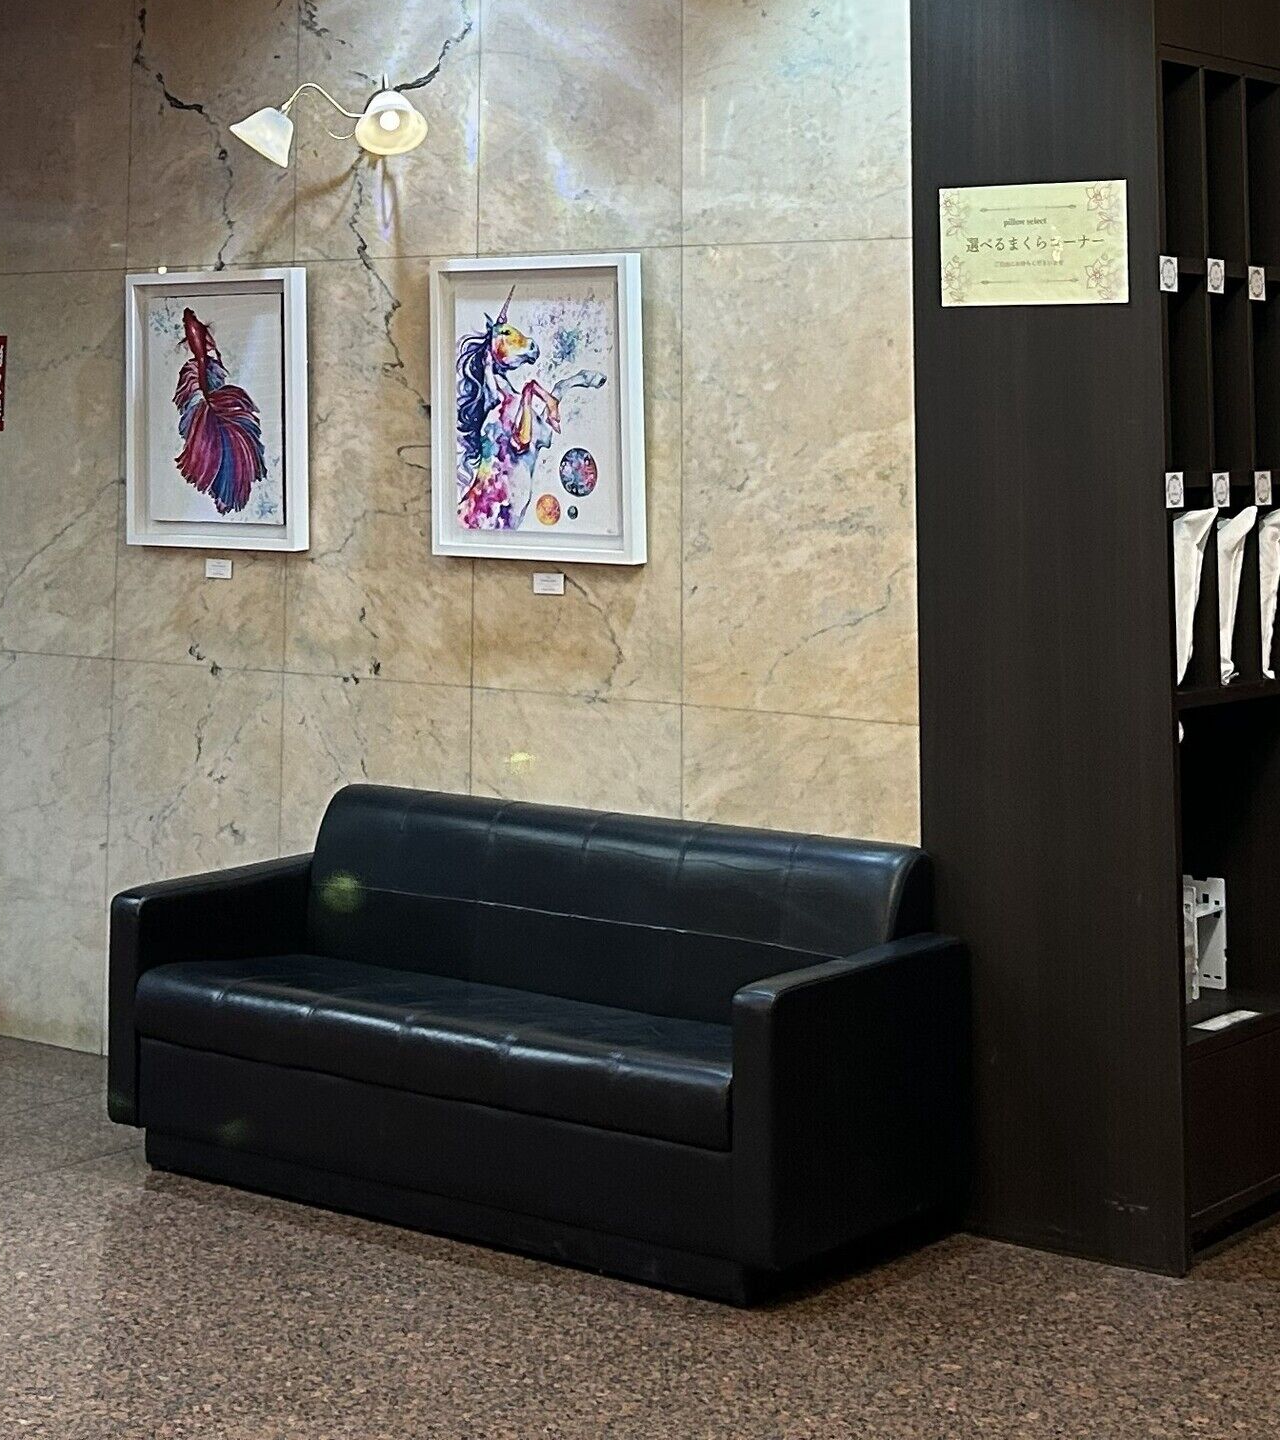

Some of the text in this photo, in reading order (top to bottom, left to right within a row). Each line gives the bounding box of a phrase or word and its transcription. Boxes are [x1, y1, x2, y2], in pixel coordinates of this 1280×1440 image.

[1003, 216, 1047, 227] pillow select
[966, 234, 1105, 253] 選べるまくらコーナー
